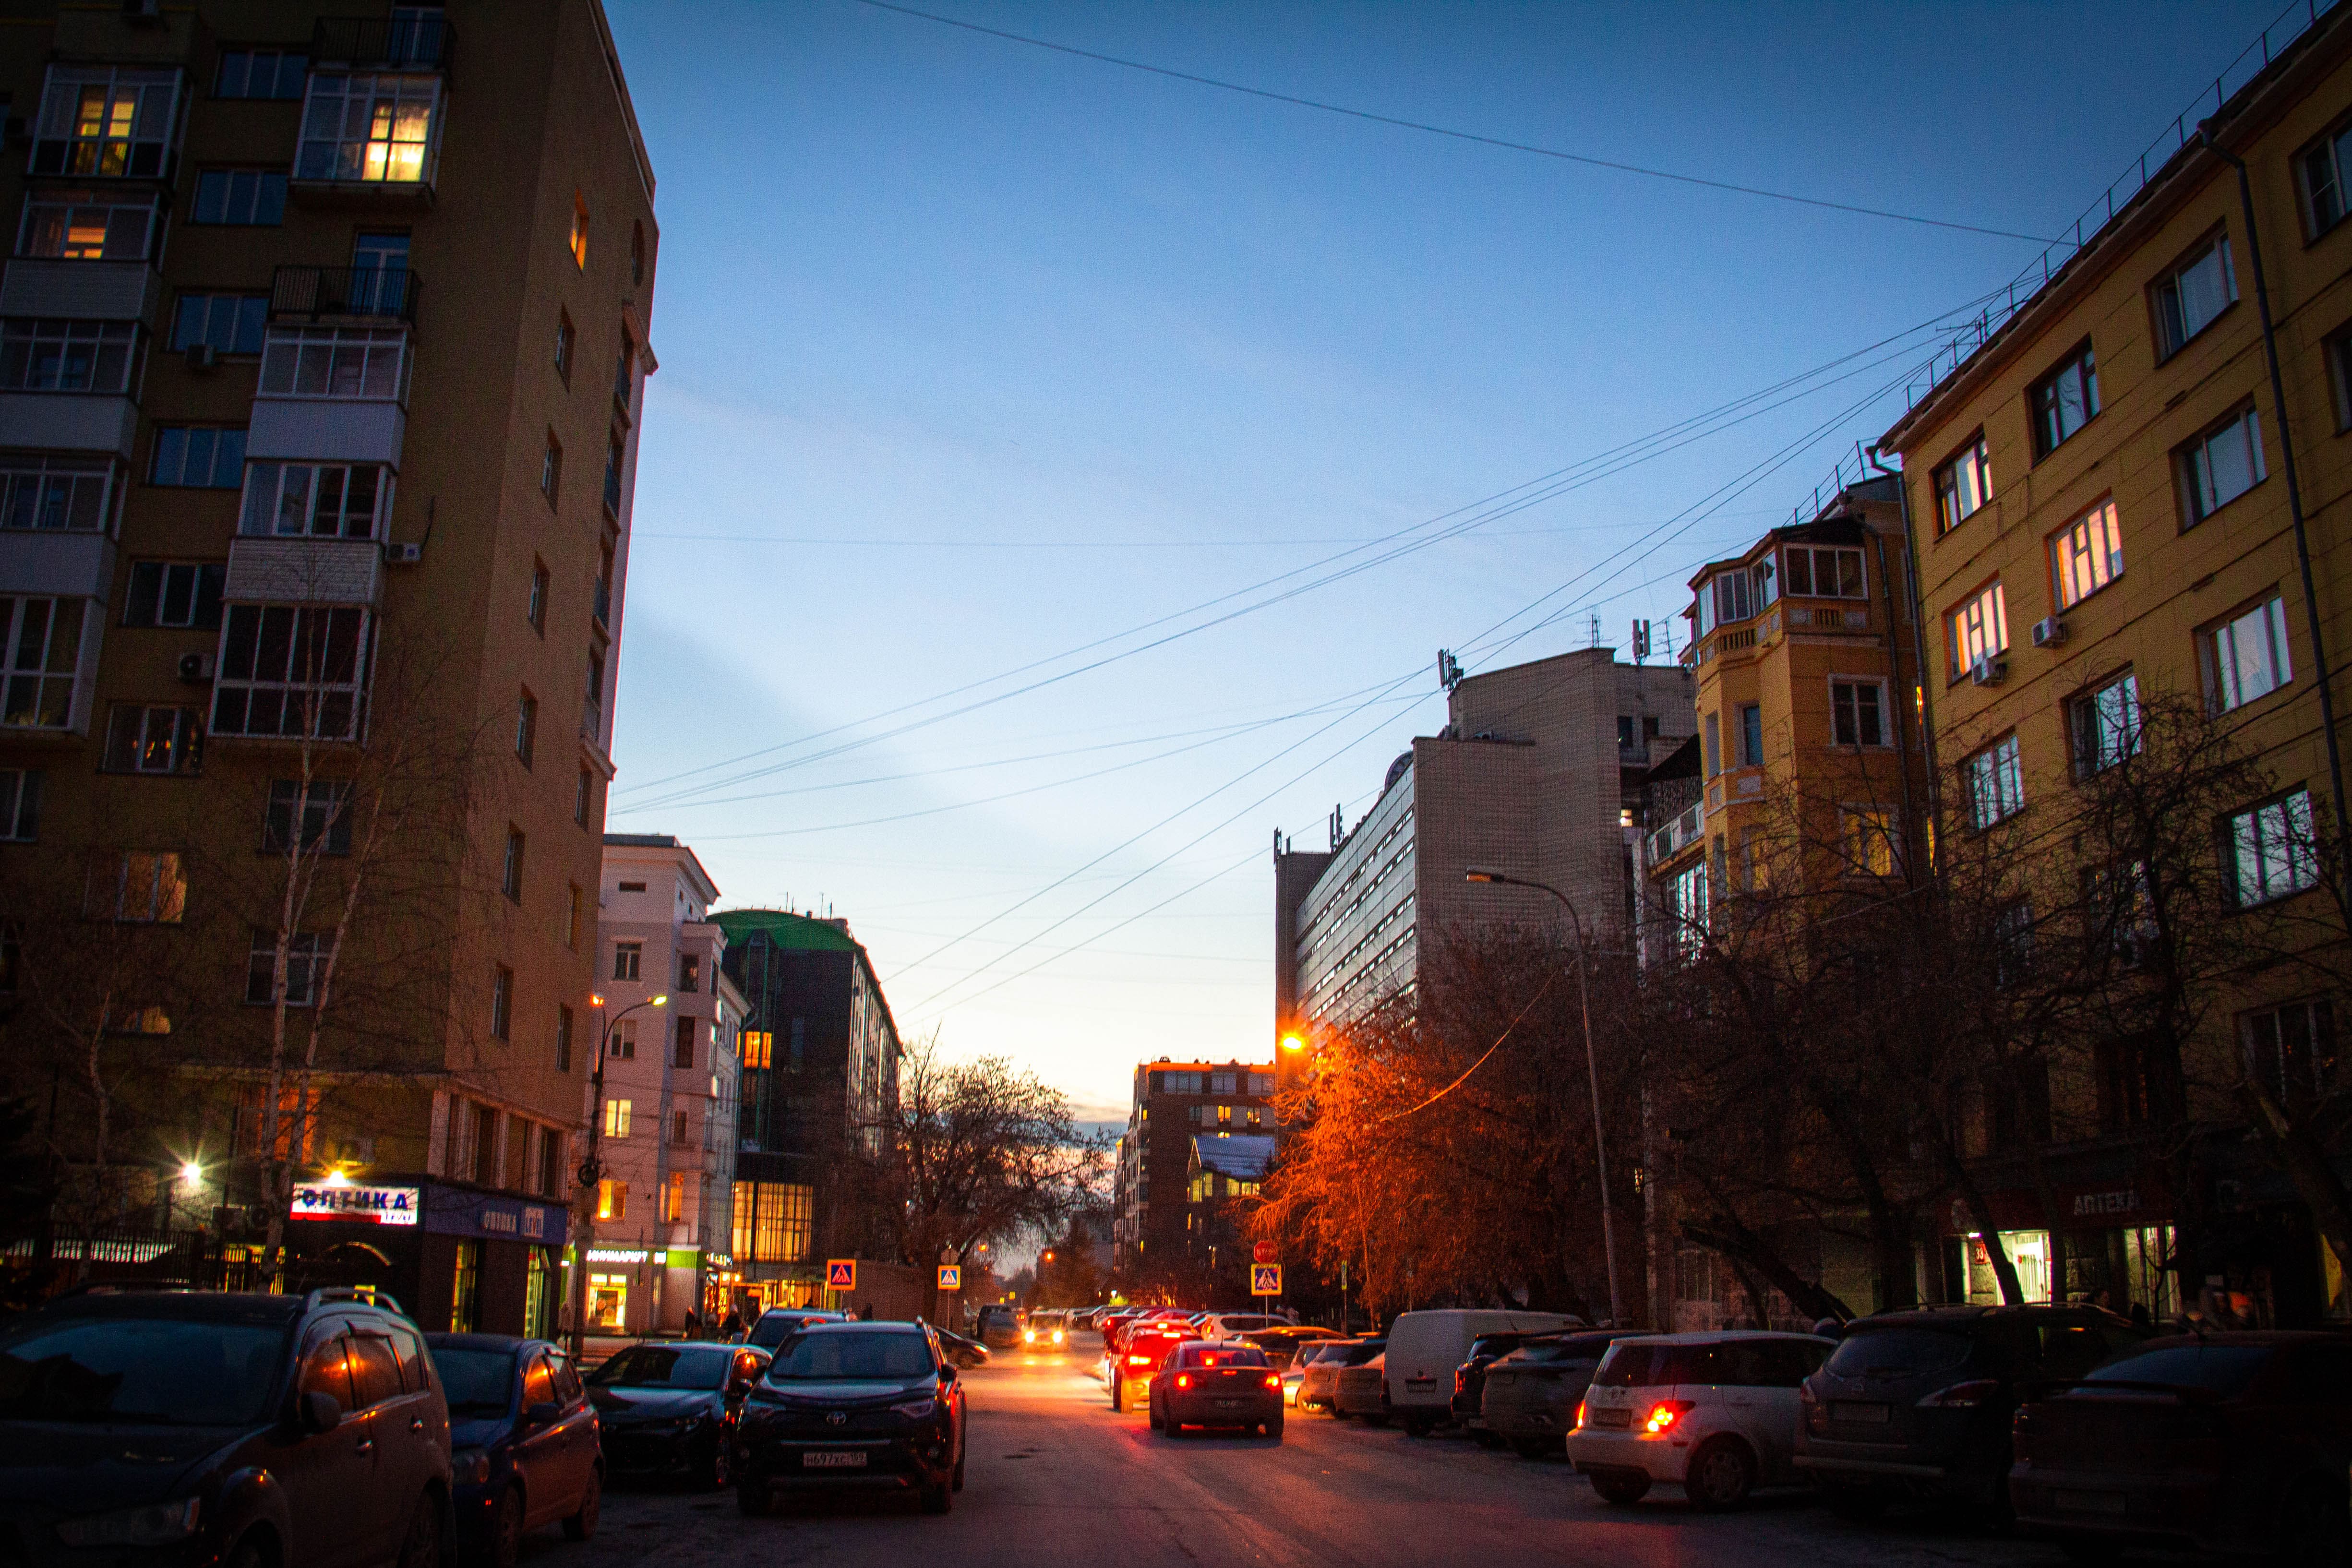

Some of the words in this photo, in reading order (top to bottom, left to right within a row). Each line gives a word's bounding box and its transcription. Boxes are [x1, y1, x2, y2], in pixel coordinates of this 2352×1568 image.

[301, 1189, 408, 1210] ОПТИКА
[2074, 1190, 2137, 1215] АПТЕКА
[484, 1211, 516, 1233] ОПТИКА
[1976, 1247, 1983, 1260] 33
